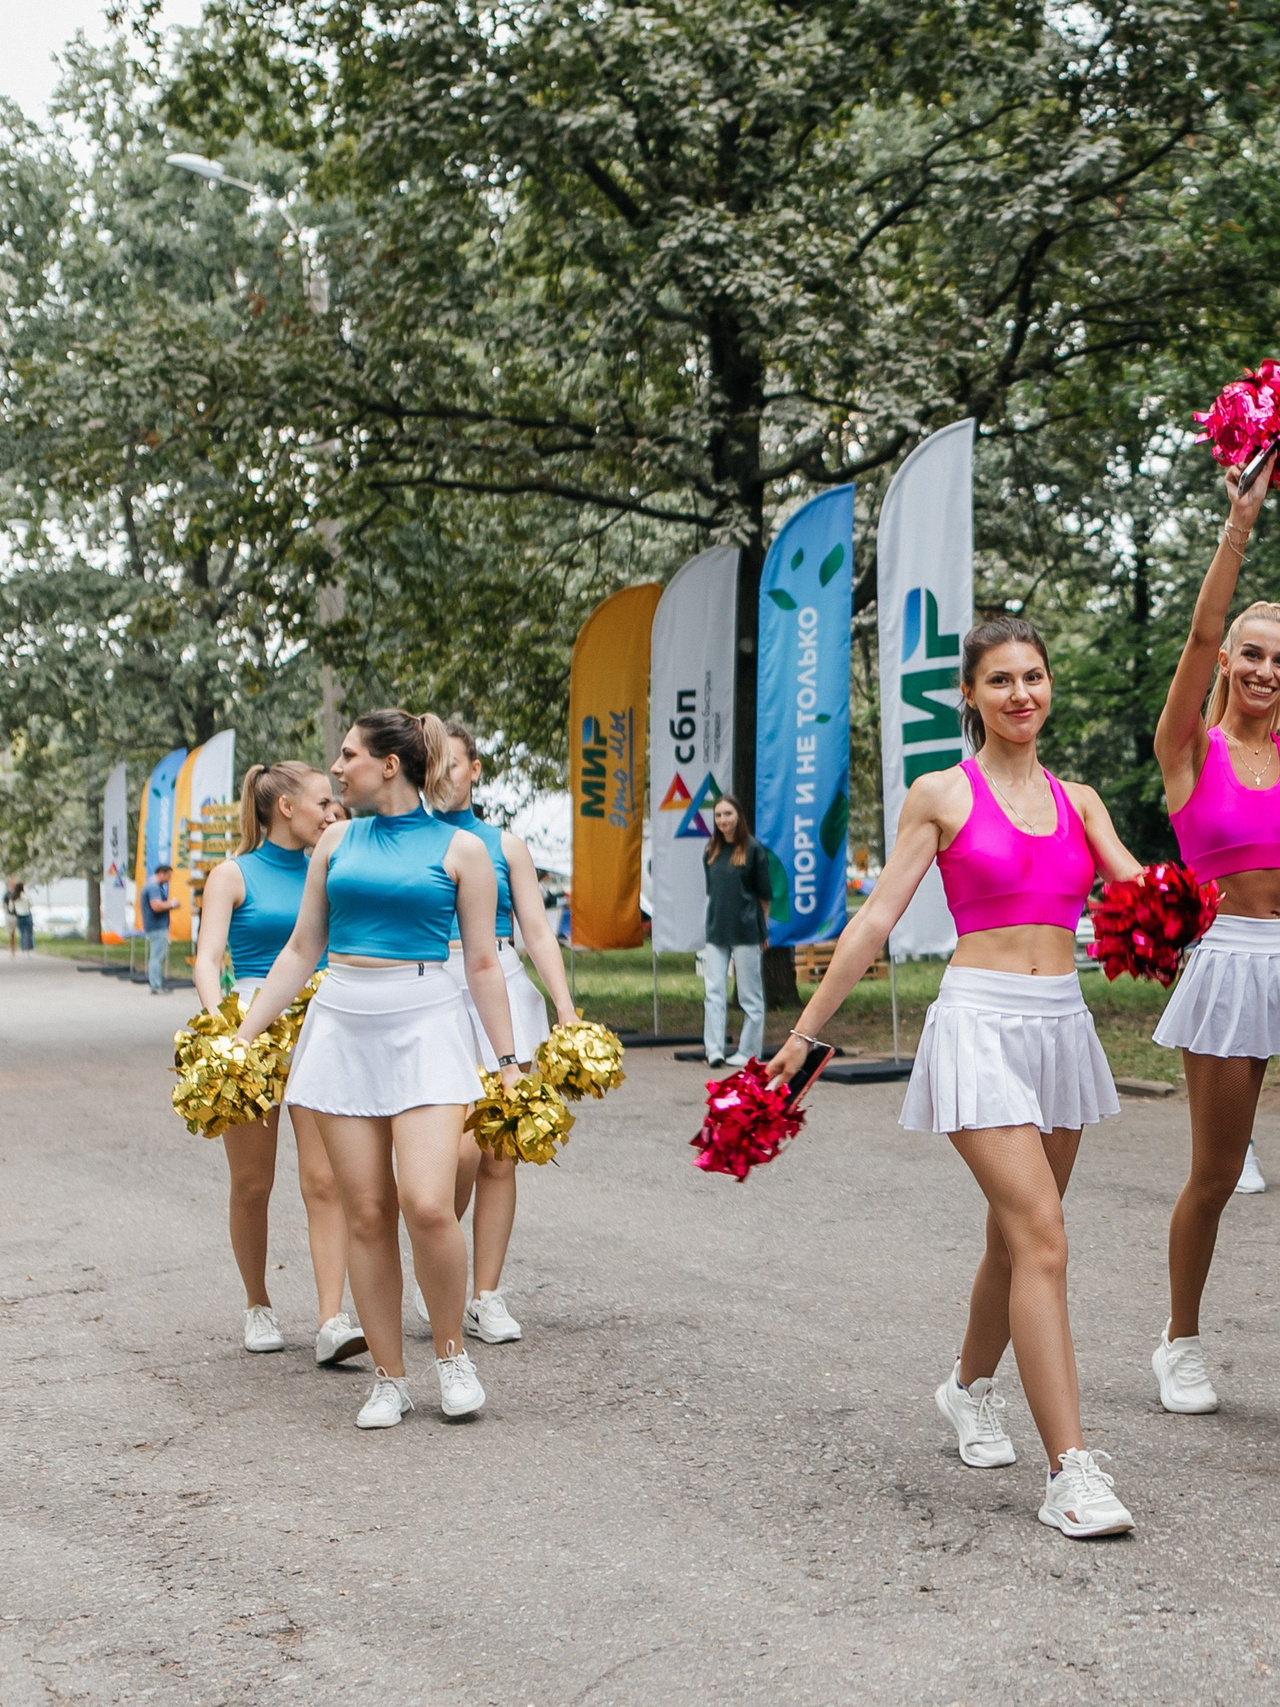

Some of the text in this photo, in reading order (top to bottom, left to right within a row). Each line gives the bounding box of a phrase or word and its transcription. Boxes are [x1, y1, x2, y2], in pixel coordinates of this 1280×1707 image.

[580, 714, 607, 819] МИР
[669, 689, 696, 764] сбп
[794, 606, 818, 915] СПОРТ И НЕ ТОЛЬКО
